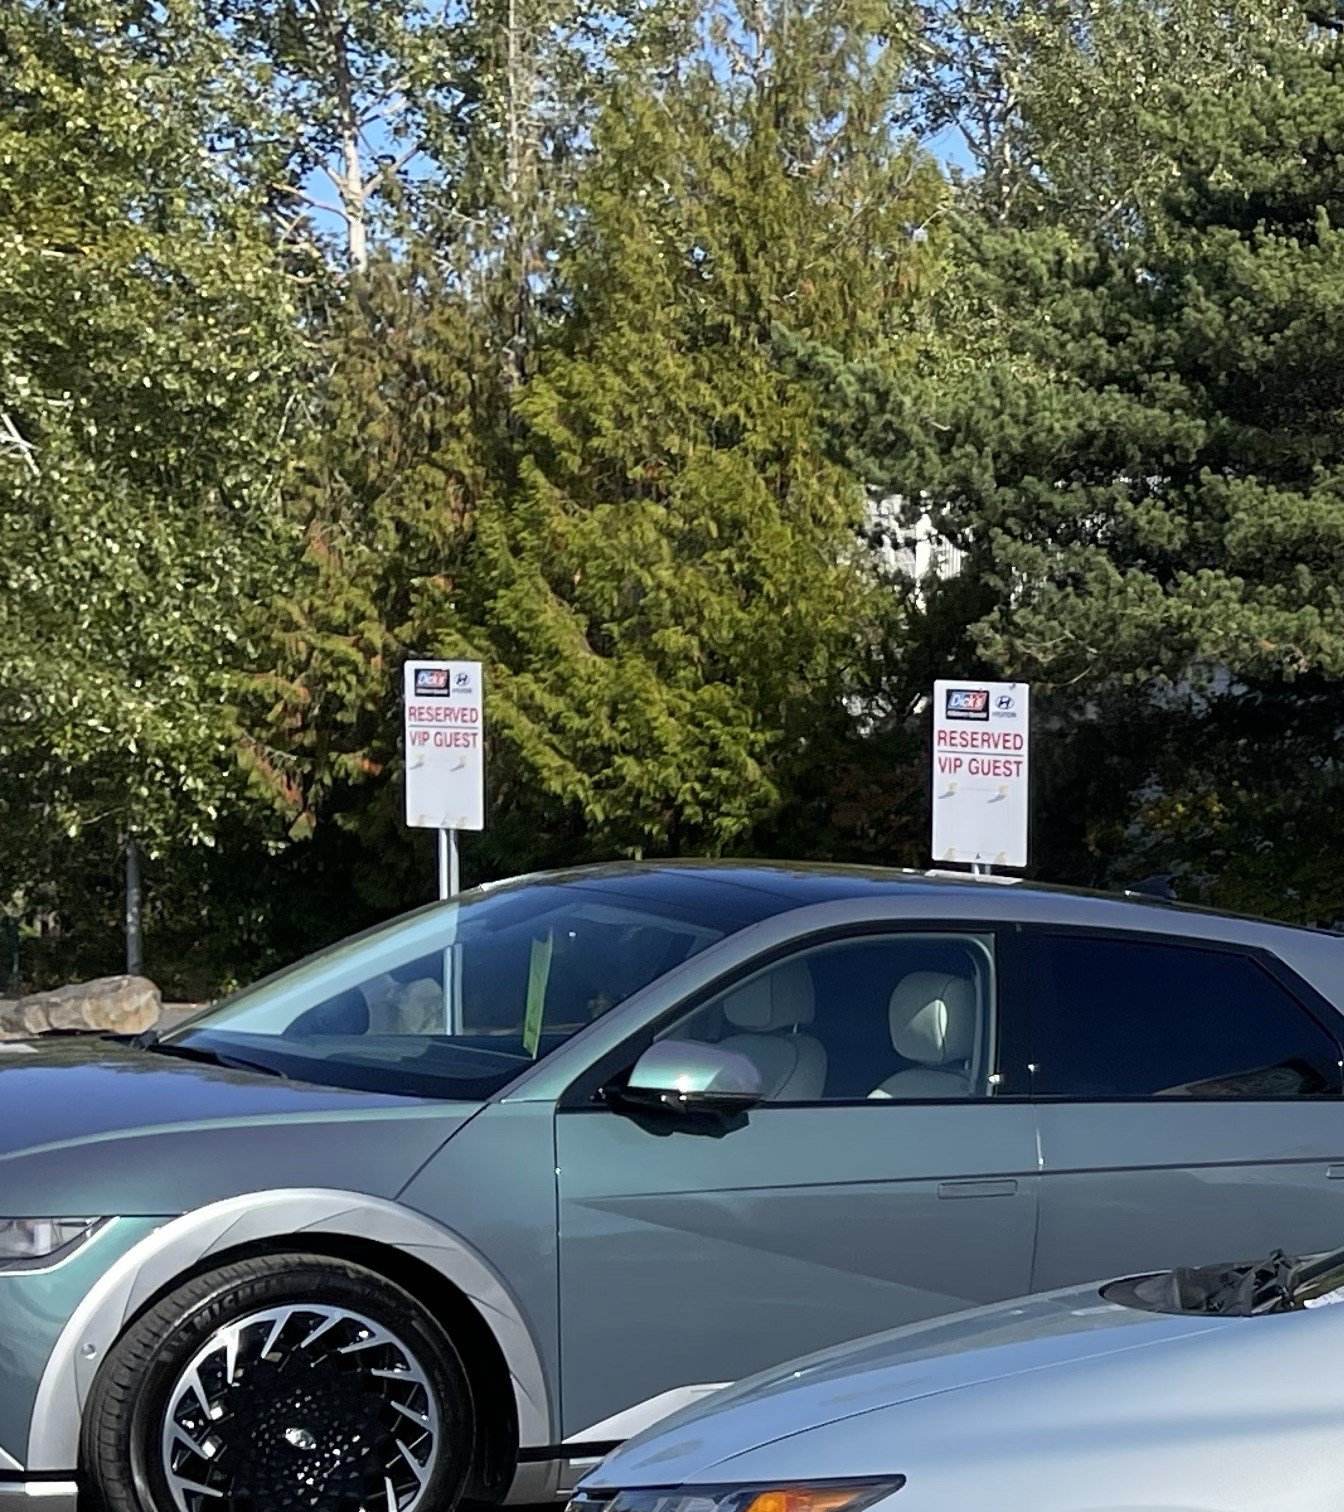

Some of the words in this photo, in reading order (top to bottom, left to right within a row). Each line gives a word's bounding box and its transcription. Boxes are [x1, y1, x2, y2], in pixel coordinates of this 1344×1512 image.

[408, 706, 478, 723] RESERVED
[409, 731, 430, 746] VIP
[434, 731, 478, 748] GUEST
[937, 730, 1024, 750] RESERVED
[938, 756, 963, 774] VIP
[968, 758, 1023, 777] GUEST
